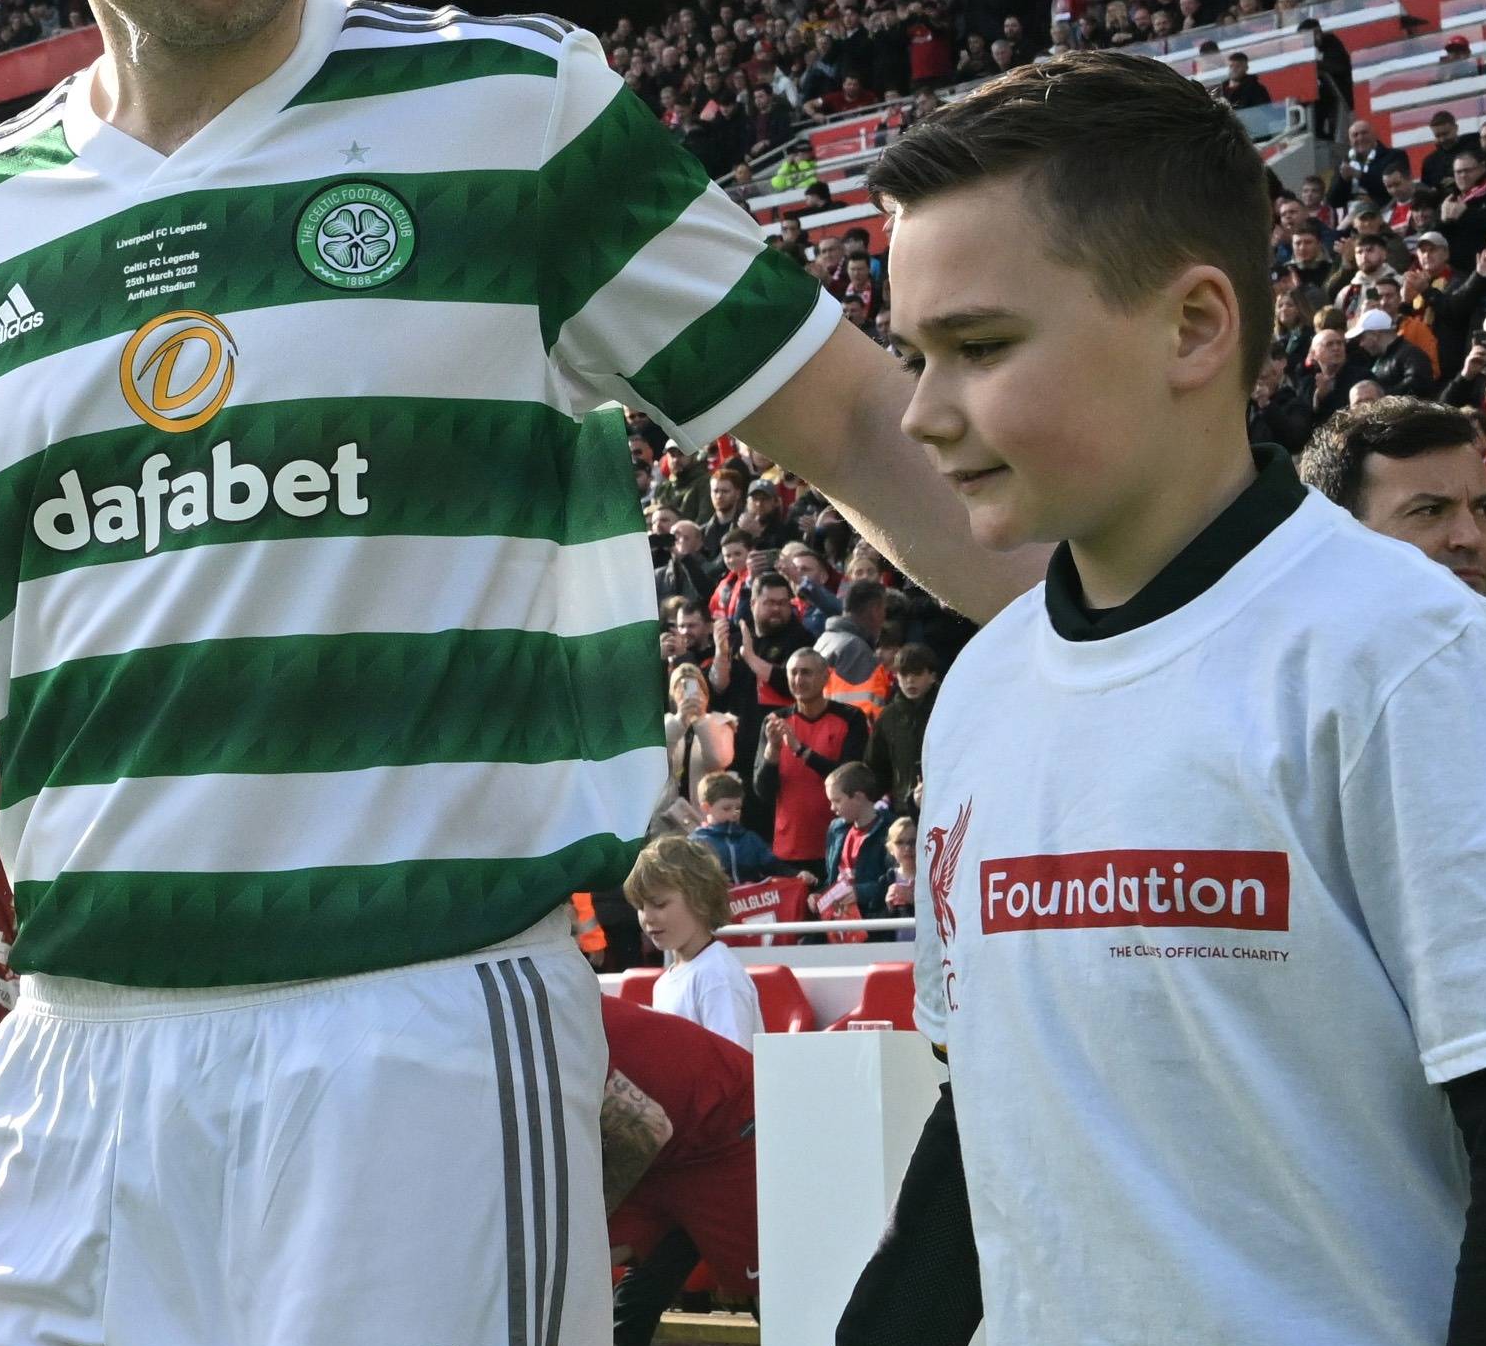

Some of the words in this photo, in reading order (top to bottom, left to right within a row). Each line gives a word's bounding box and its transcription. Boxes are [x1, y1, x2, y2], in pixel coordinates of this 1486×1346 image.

[300, 222, 316, 245] THE
[310, 192, 340, 223] CELTIC
[341, 188, 397, 212] FOOTBALL
[394, 209, 412, 238] CLUB
[116, 229, 155, 249] Liverpool
[155, 227, 168, 238] FC
[169, 221, 208, 235] Legends
[123, 260, 148, 274] Celtic
[149, 257, 161, 268] FC
[162, 250, 200, 265] Legends
[125, 275, 145, 288] 25th
[146, 269, 174, 283] March
[175, 264, 198, 277] 2023
[127, 285, 158, 302] Anfield
[159, 280, 196, 294] Stadium
[33, 439, 369, 554] dafabet
[729, 890, 781, 916] DALGLISH
[987, 861, 1266, 921] Foundation
[1109, 946, 1132, 958] THE
[1164, 946, 1229, 959] OFFICIAL
[1232, 947, 1290, 963] CHARITY
